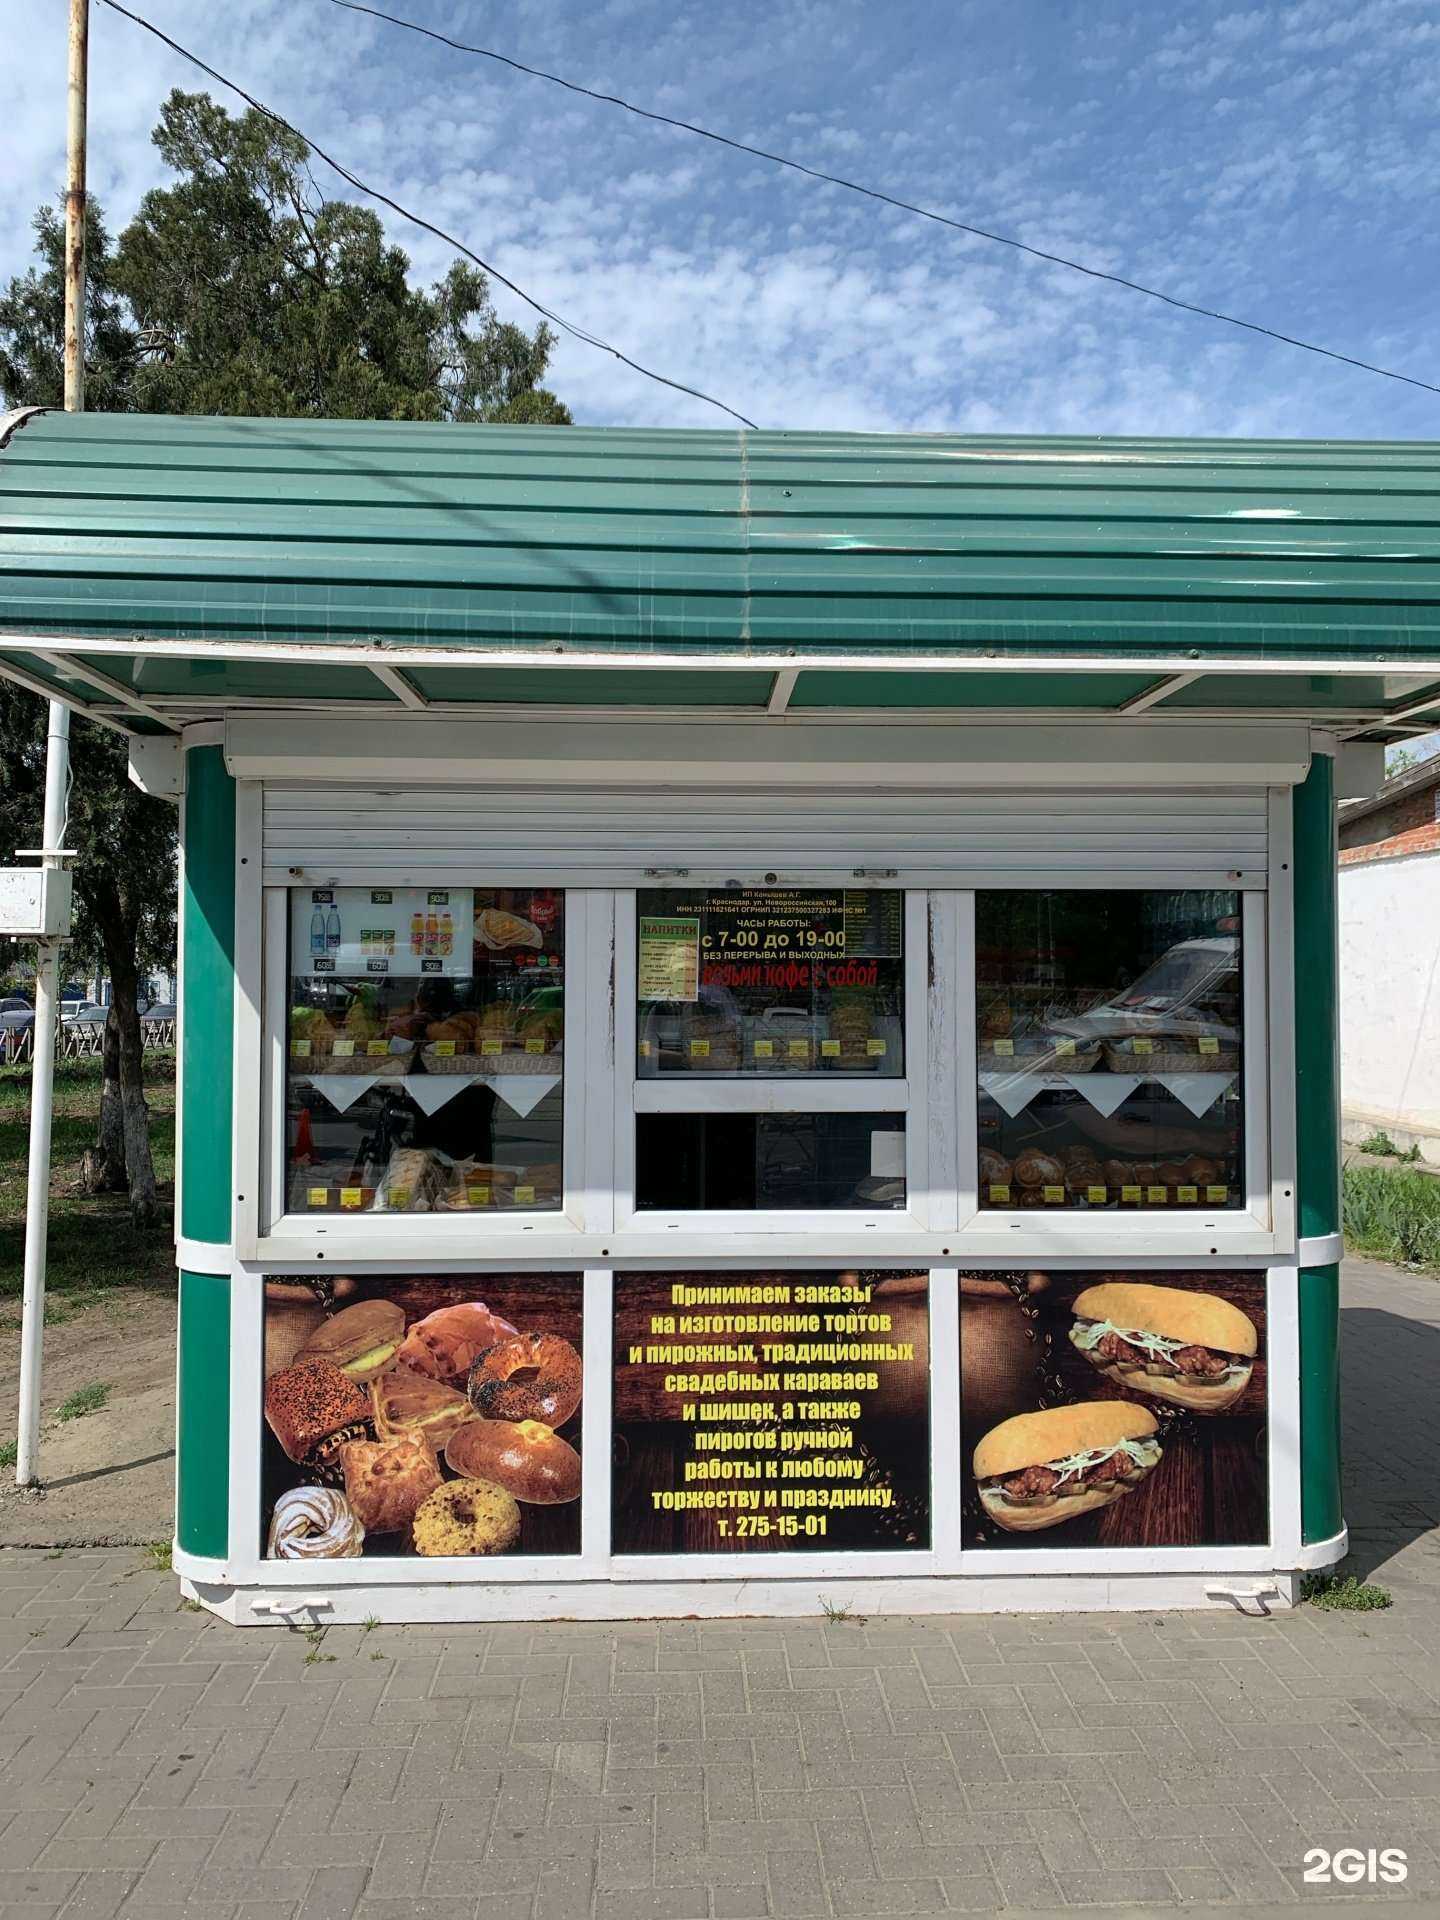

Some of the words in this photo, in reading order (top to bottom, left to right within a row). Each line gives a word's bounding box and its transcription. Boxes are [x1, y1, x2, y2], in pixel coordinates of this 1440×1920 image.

[676, 906, 692, 914] ИНН
[741, 906, 771, 914] ОГРНИП
[642, 925, 697, 935] НАПИТКИ
[737, 919, 766, 928] ЧАСЫ
[767, 919, 812, 928] РАБОТЫ:
[701, 934, 713, 948] с
[718, 931, 759, 947] 7-00
[764, 934, 790, 949] до
[796, 931, 846, 947] 19-00
[703, 952, 722, 960] БЕЗ
[724, 951, 778, 960] ПЕРЕРЫВА
[779, 951, 787, 959] И
[788, 951, 845, 960] ВЫХОДНЫХ
[765, 961, 809, 991] кофе
[826, 960, 879, 987] собой
[672, 1284, 790, 1305] Принимаем
[795, 1285, 871, 1303] заказы
[651, 1315, 675, 1334] на
[680, 1314, 820, 1333] изготовление
[824, 1314, 891, 1333] тортов
[630, 1345, 642, 1364] и
[647, 1343, 758, 1365] пирожных,
[762, 1343, 914, 1363] традиционных
[665, 1371, 779, 1394] свадебных
[784, 1372, 878, 1392] караваев
[683, 1404, 696, 1421] и
[700, 1402, 782, 1422] шишек,
[783, 1402, 794, 1420] а
[798, 1401, 860, 1419] также
[696, 1431, 776, 1451] пирогов
[782, 1428, 853, 1450] ручной
[685, 1459, 761, 1480] работы
[766, 1461, 777, 1479] к
[782, 1458, 863, 1479] любому
[652, 1490, 760, 1509] торжеству
[765, 1490, 777, 1507] и
[782, 1488, 896, 1509] празднику.
[718, 1519, 732, 1537] т.
[737, 1515, 826, 1537] 275-15-01
